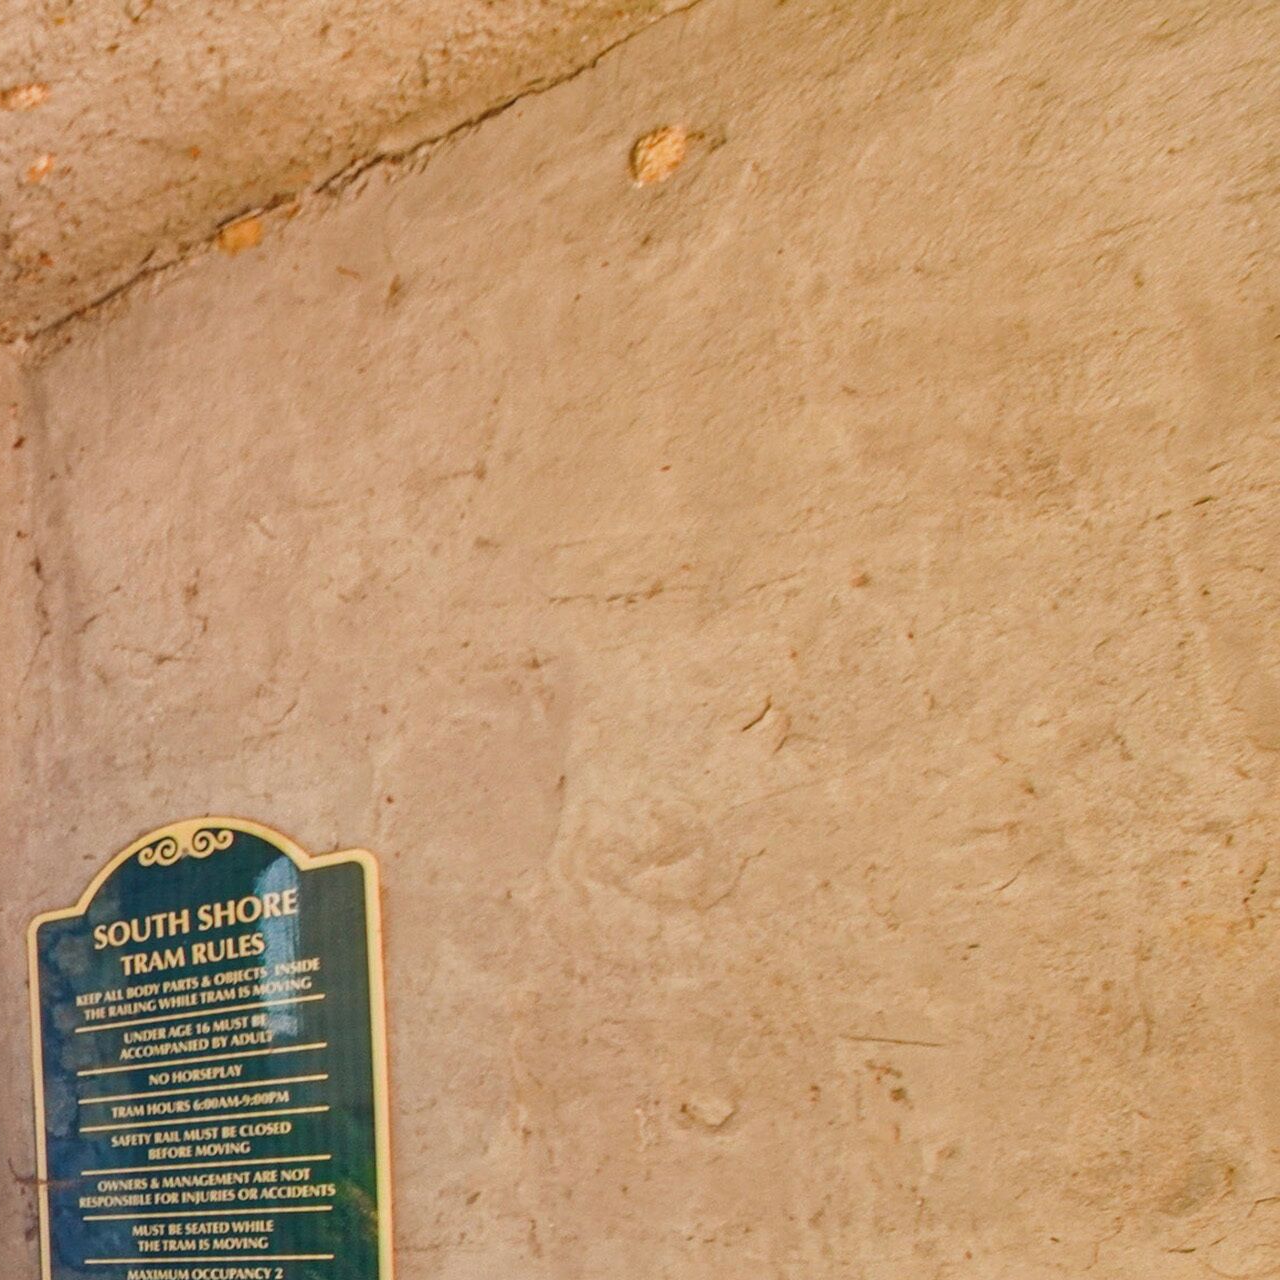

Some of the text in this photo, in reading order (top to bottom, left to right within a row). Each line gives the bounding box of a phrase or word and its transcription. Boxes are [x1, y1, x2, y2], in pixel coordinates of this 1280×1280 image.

[93, 888, 299, 950] SOUTH SHORE
[120, 933, 266, 976] TRAM RULES
[76, 958, 320, 1007] KEEP ALL BODY PARTS & OBJECTS INSIDE
[84, 977, 312, 1022] THE RAILING WHILE TRAM IS MOVING
[124, 1015, 267, 1045] UNDER AGE 16 MUST BE
[120, 1031, 273, 1060] ACCOMPANIED BY ADULT
[149, 1064, 243, 1086] NO HORSEPLAY
[112, 1091, 289, 1118] TRAM HOURS 6:00AM-9:00PM
[111, 1121, 291, 1148] SAFETY RAIL MUST BE CLOSED
[149, 1141, 250, 1160] BEFORE MOVING
[98, 1168, 310, 1192] OWNERS & MANAGEMENT ARE NOT
[79, 1183, 336, 1208] RESPONSIBLE FOR INJURIES OR ACCIDENTS
[132, 1219, 274, 1236] MUST BE SEATED WHILE
[138, 1236, 268, 1252] THE TRAM IS MOVING
[127, 1268, 284, 1280] MAXIMUM OCCUPANCY 2
